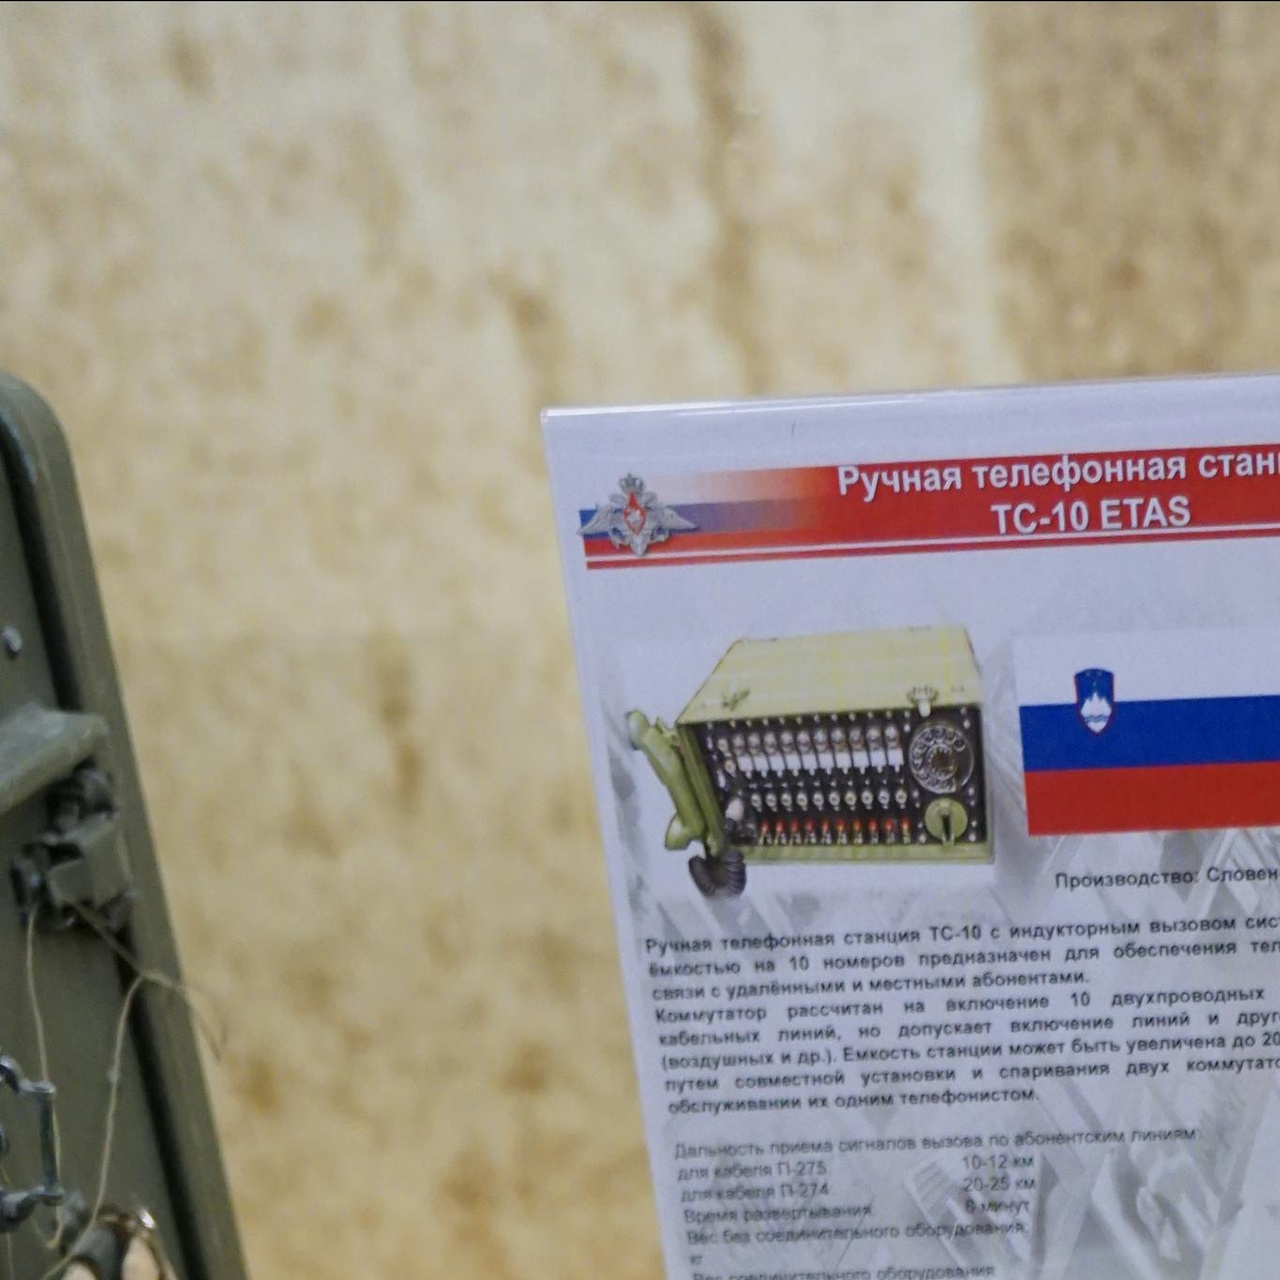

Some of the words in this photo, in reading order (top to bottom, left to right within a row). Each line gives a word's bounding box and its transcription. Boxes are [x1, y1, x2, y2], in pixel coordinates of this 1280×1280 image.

[838, 464, 962, 502] Ручная
[973, 453, 1187, 491] телефонная
[1100, 496, 1192, 529] ETAS
[1055, 870, 1199, 891] Производство:
[644, 936, 713, 956] Ручная
[720, 931, 836, 952] телефонная
[843, 929, 921, 945] станция
[928, 923, 982, 941] ТС-10
[989, 926, 1001, 938] с
[1008, 920, 1141, 940] индукторным
[1149, 916, 1237, 932] вызовом
[649, 960, 741, 976] ёмкостью
[754, 960, 775, 972] на
[789, 954, 809, 971] 10
[823, 954, 905, 972] номеров
[919, 949, 1051, 969] предназначен
[1065, 947, 1099, 962] для
[1113, 941, 1237, 958] обеспечения
[651, 986, 706, 1001] связи
[710, 986, 721, 998] с
[725, 979, 846, 1001] удалёнными
[851, 980, 864, 992] и
[868, 975, 966, 991] местными
[972, 970, 1090, 987] абонентами.
[654, 1006, 768, 1025] Коммутатор
[786, 1002, 884, 1022] рассчитан
[903, 1000, 926, 1013] на
[945, 996, 1050, 1012] включение
[1070, 990, 1091, 1007] 10
[1110, 988, 1265, 1008] двухпроводных
[658, 1028, 760, 1045] кабельных
[778, 1023, 841, 1041] линий,
[858, 1025, 881, 1038] но
[898, 1021, 992, 1039] допускает
[1010, 1017, 1114, 1032] включение
[1132, 1010, 1190, 1028] линий
[1207, 1013, 1220, 1025] и
[660, 1052, 774, 1072] (воздушных
[780, 1051, 792, 1064] и
[797, 1046, 837, 1067] др.).
[842, 1045, 921, 1062] Емкость
[926, 1044, 1003, 1059] станции
[1008, 1042, 1065, 1056] может
[1070, 1037, 1121, 1053] быть
[1125, 1036, 1227, 1055] увеличена
[1231, 1035, 1256, 1050] до
[664, 1077, 719, 1094] путем
[734, 1068, 845, 1088] совместной
[860, 1068, 956, 1088] установки
[971, 1067, 984, 1080] и
[998, 1063, 1110, 1082] спаривания
[1125, 1061, 1170, 1078] двух
[668, 1097, 801, 1116] обслуживании
[807, 1096, 828, 1108] их
[835, 1093, 894, 1109] одним
[901, 1087, 1042, 1107] телефонистом.
